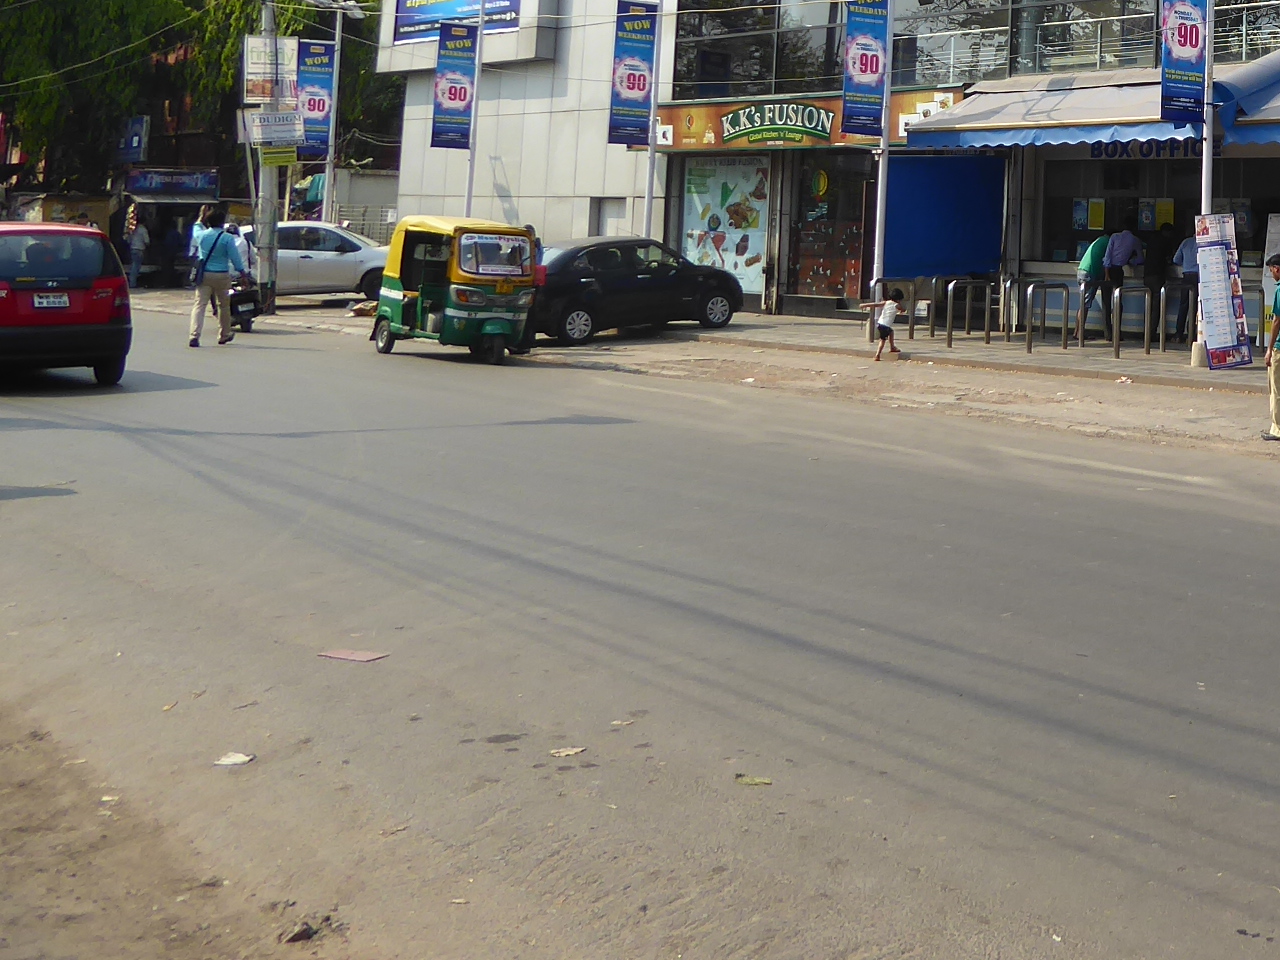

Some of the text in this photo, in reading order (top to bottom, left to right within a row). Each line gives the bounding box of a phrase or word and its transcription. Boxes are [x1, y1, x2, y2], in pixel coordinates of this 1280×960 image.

[624, 20, 652, 31] WOW
[1178, 22, 1199, 49] 90
[445, 39, 472, 50] WOW
[305, 56, 329, 66] WOW
[860, 53, 880, 74] 90
[626, 72, 647, 92] 90
[448, 86, 467, 101] 90
[307, 98, 325, 112] 90
[722, 106, 761, 136] K.K's
[764, 104, 834, 133] FUSION
[1090, 140, 1132, 158] BOX
